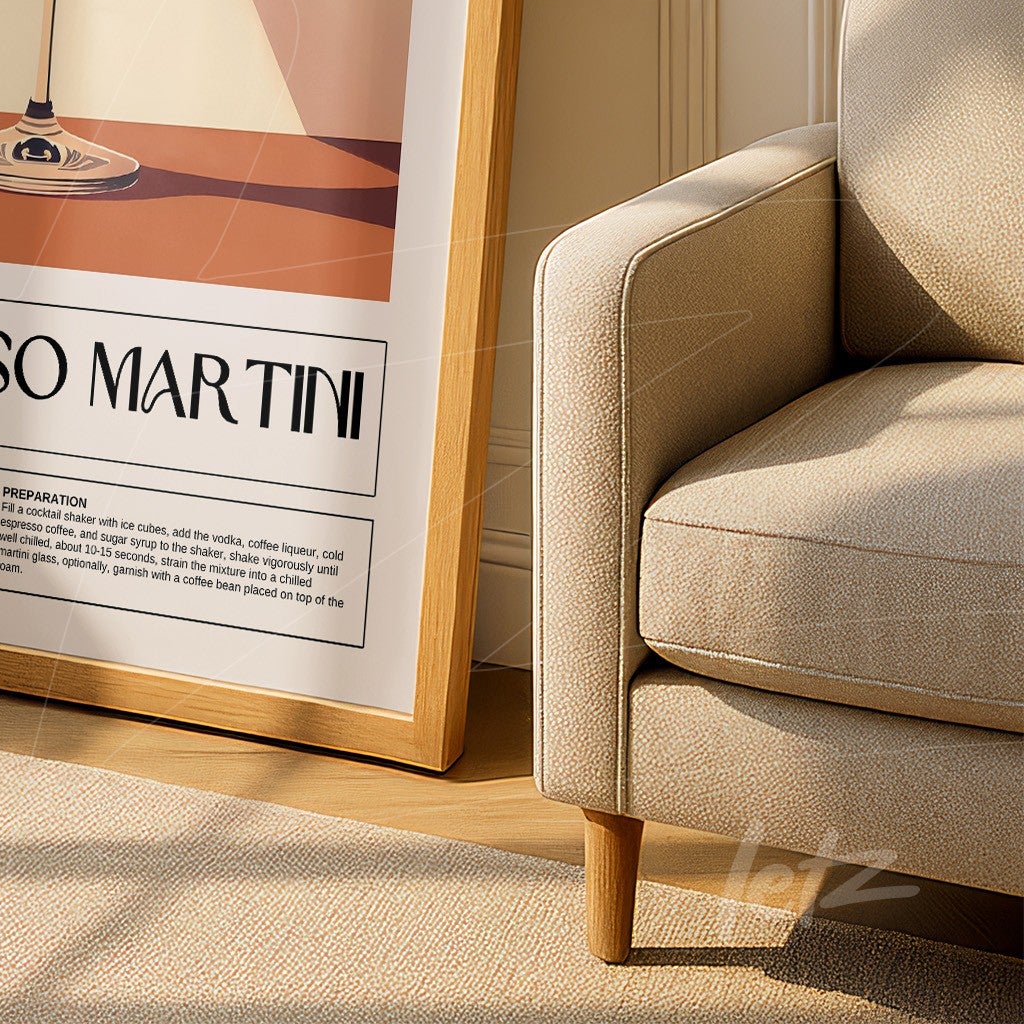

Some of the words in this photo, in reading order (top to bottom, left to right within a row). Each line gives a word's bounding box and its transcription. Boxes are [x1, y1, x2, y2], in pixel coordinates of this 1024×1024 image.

[90, 342, 364, 439] MARTINI
[2, 486, 88, 510] PREPARATION
[0, 518, 45, 533] espresso
[44, 523, 77, 539] coffee,
[78, 529, 99, 541] and
[99, 532, 129, 547] sugar
[129, 537, 158, 552] syrup
[159, 539, 170, 552] to
[171, 541, 189, 554] the
[189, 544, 227, 562] shaker,
[228, 550, 261, 566] shake
[262, 555, 316, 576] vigorously
[316, 564, 339, 577] until
[1, 501, 16, 514] Fill
[16, 505, 24, 515] a
[25, 506, 62, 522] cocktail
[63, 510, 97, 526] shaker
[98, 516, 119, 529] with
[120, 518, 136, 532] ice
[137, 522, 170, 538] cubes,
[171, 527, 192, 540] add
[193, 529, 210, 542] the
[211, 534, 246, 549] vodka,
[247, 538, 280, 553] coffee
[281, 542, 320, 561] liqueur,
[322, 549, 344, 562] cold
[19, 534, 53, 551] chilled,
[54, 539, 83, 554] about
[84, 543, 113, 559] 10-15
[114, 550, 159, 567] seconds,
[160, 556, 189, 570] strain
[190, 559, 207, 573] the
[208, 563, 247, 579] mixture
[248, 567, 268, 582] into
[269, 573, 278, 584] a
[279, 573, 313, 589] chilled
[31, 551, 60, 567] glass,
[61, 556, 110, 575] optionally,
[112, 565, 149, 579] garnish
[150, 569, 172, 582] with
[173, 574, 181, 584] a
[182, 575, 215, 589] coffee
[215, 578, 242, 593] bean
[243, 583, 279, 599] placed
[279, 590, 294, 601] on
[295, 591, 313, 606] top
[314, 594, 326, 606] of
[327, 596, 345, 609] the
